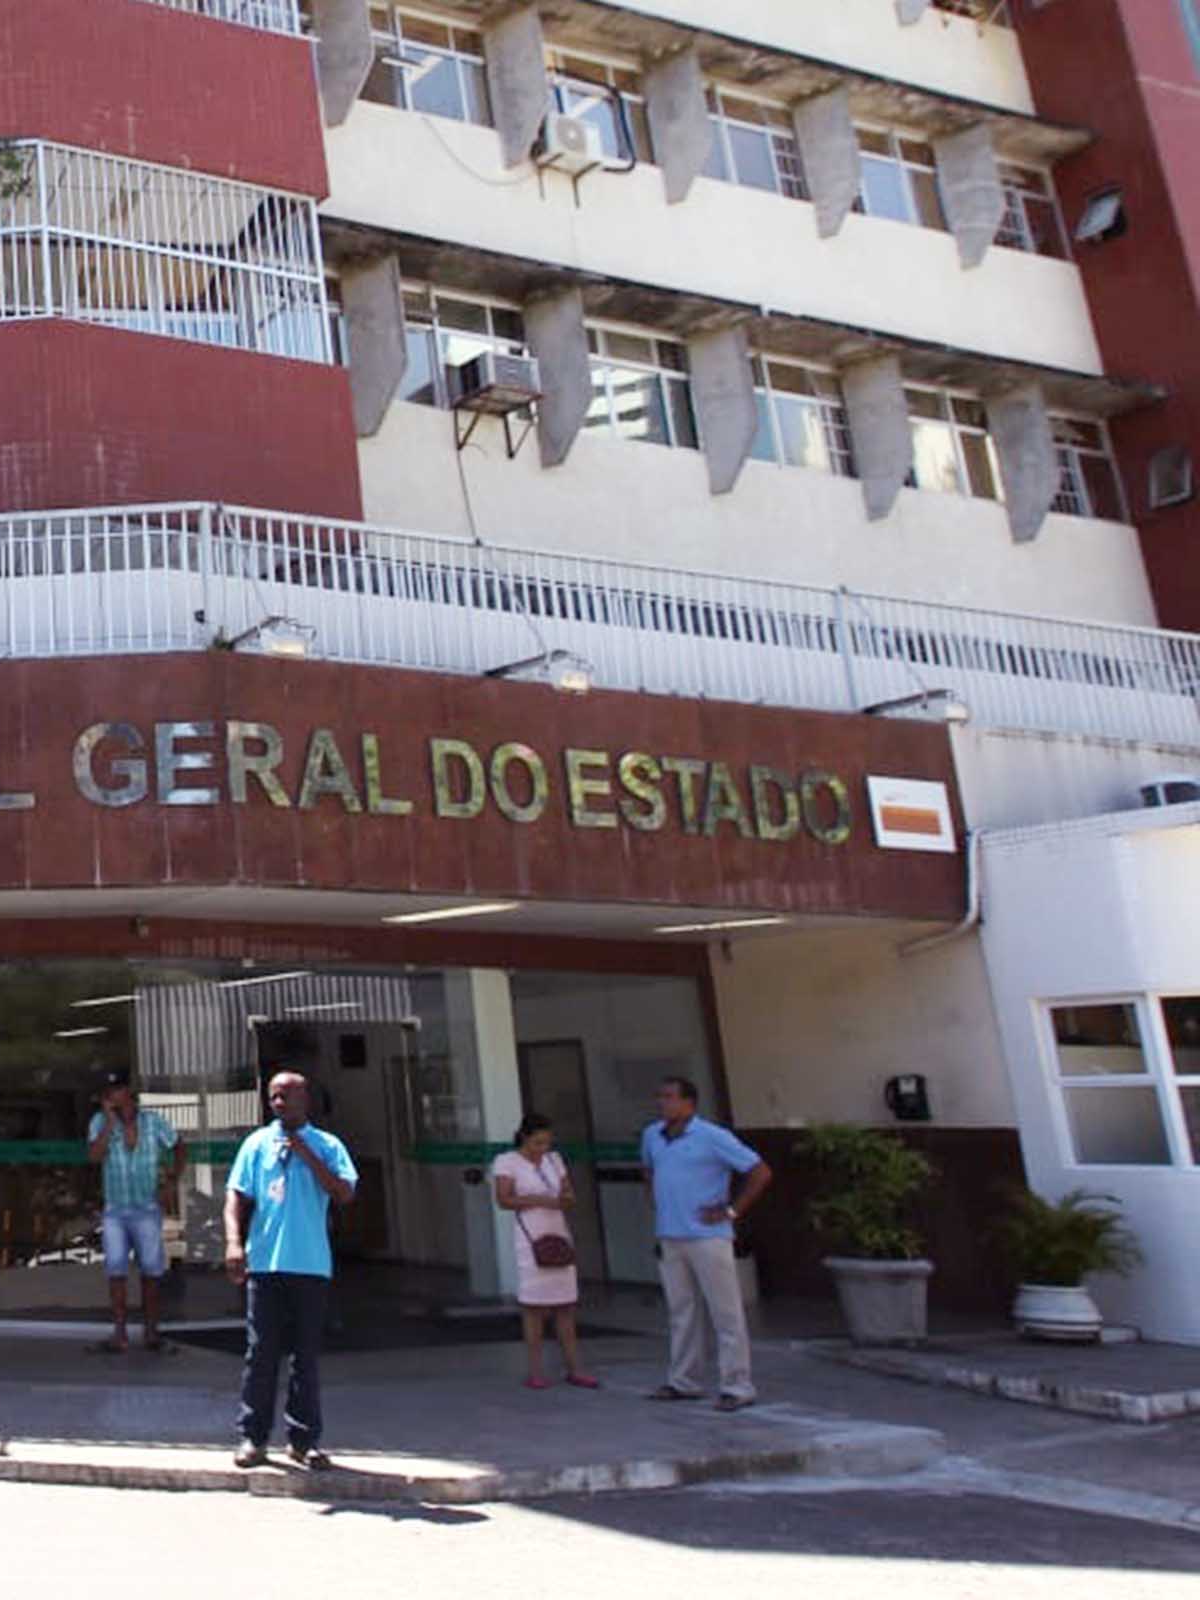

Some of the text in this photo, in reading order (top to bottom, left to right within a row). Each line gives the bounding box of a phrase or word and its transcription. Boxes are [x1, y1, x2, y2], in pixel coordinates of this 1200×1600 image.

[74, 720, 413, 817] GERAL
[430, 738, 549, 824] DO
[564, 748, 852, 846] ESTADO
